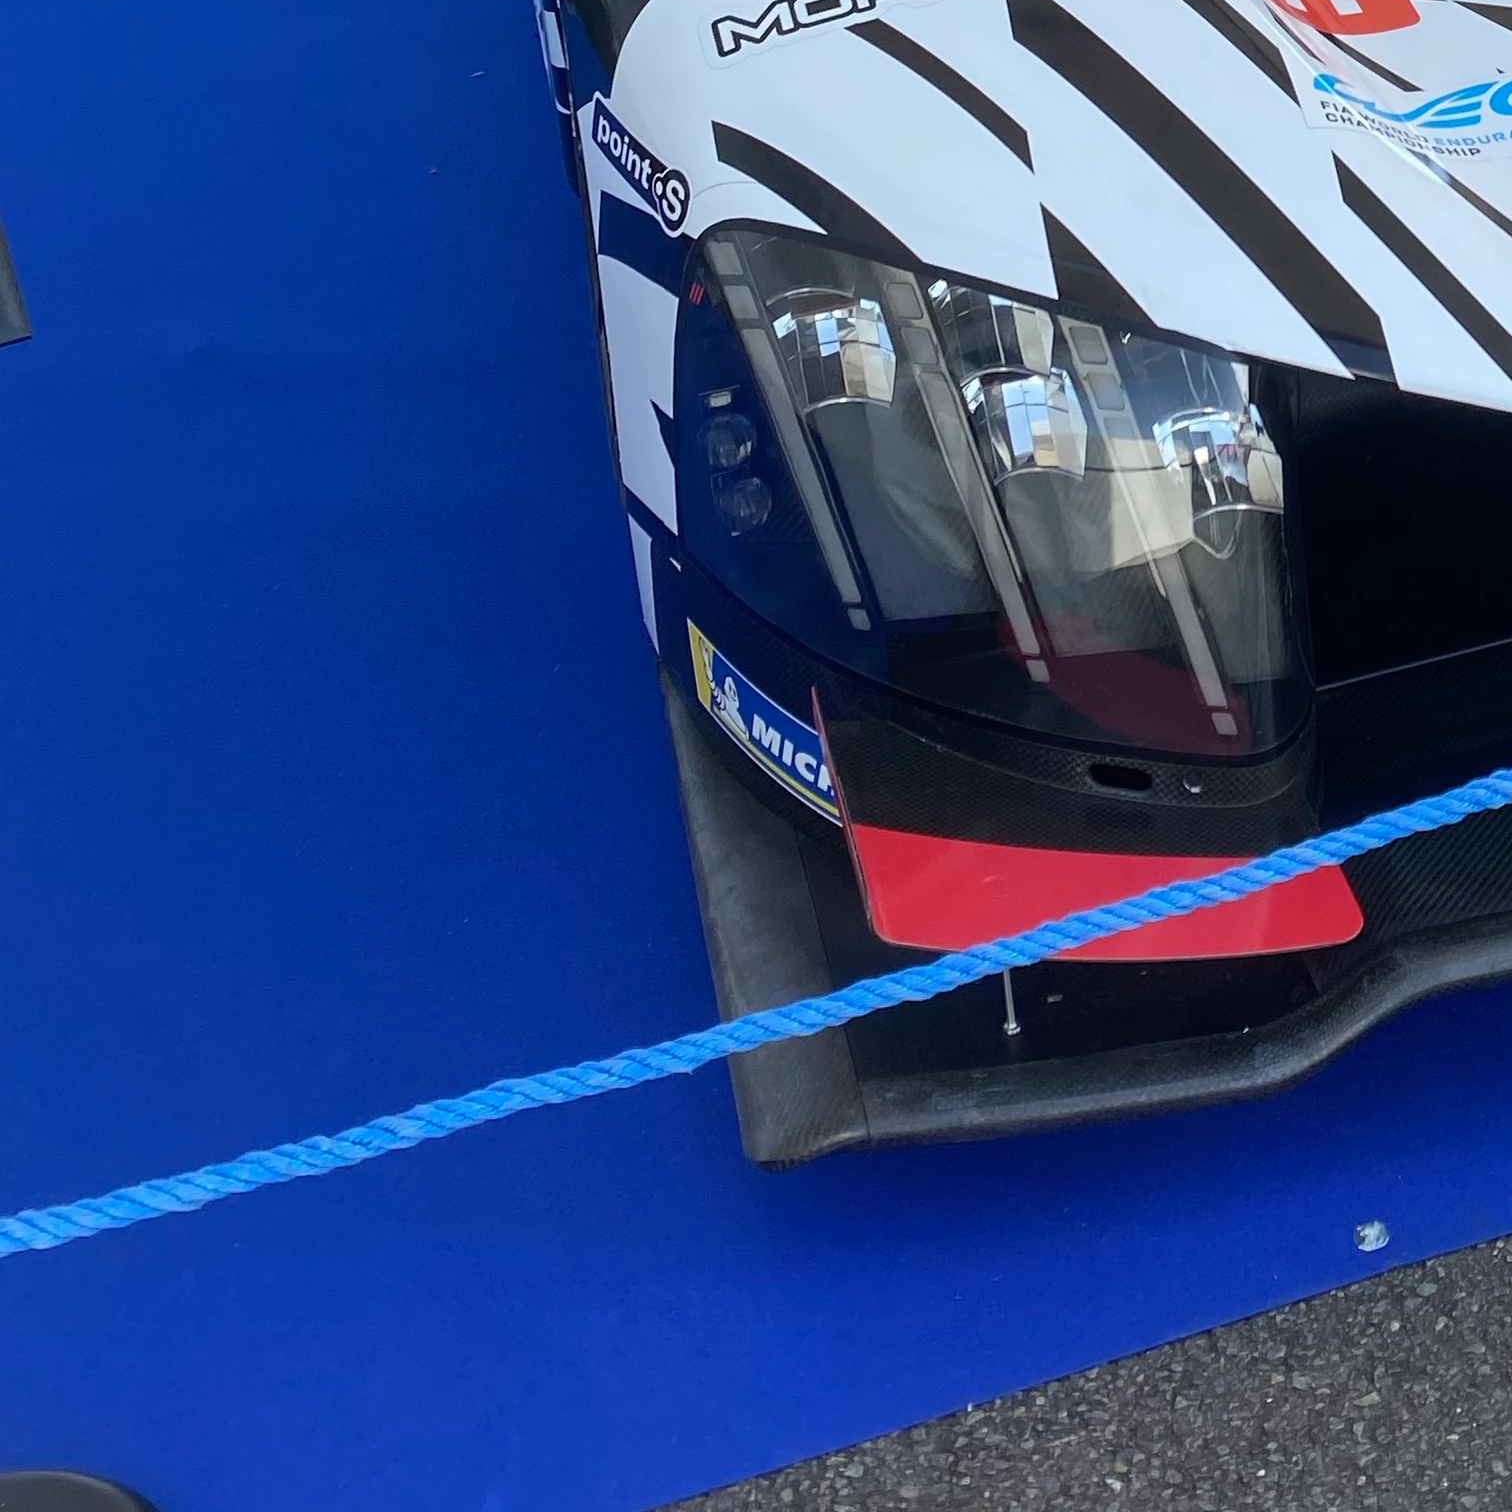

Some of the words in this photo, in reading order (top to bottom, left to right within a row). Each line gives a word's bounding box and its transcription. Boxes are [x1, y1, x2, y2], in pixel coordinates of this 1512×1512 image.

[1319, 99, 1355, 117] FIA
[1359, 113, 1430, 144] WORLD
[1325, 112, 1483, 158] CHAMPIONSHIP
[596, 113, 653, 191] point
